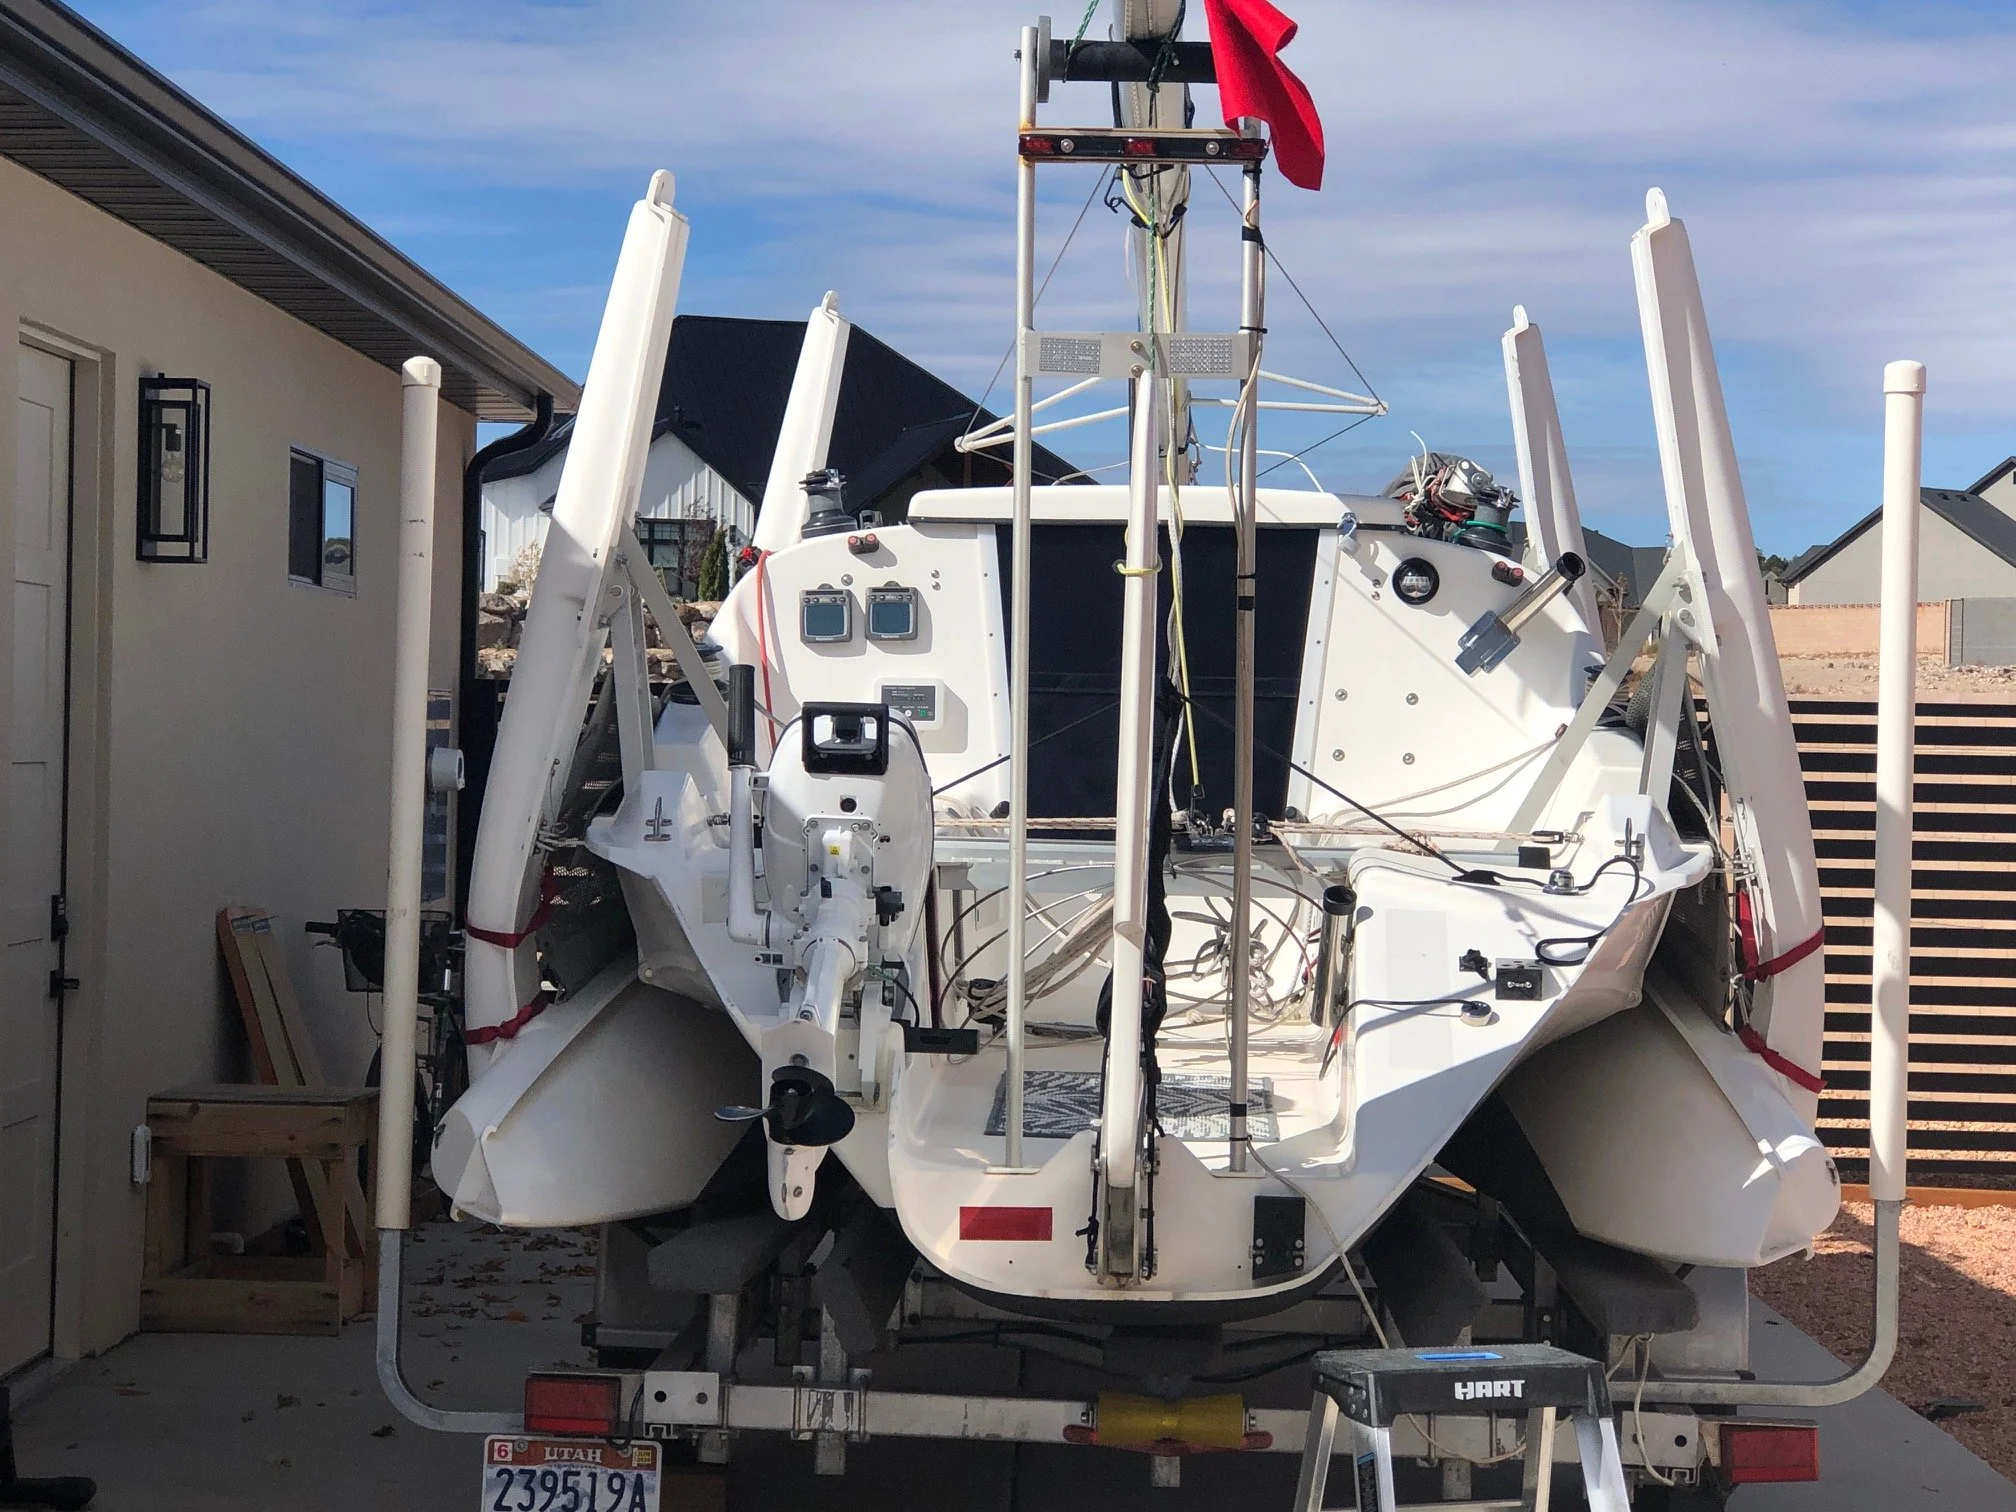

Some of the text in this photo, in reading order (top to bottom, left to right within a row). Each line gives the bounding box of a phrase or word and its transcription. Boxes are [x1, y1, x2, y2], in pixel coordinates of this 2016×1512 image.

[1454, 1379, 1526, 1400] HART
[496, 1444, 509, 1459] 6
[543, 1447, 602, 1463] UTAH
[493, 1468, 647, 1512] 239519A
